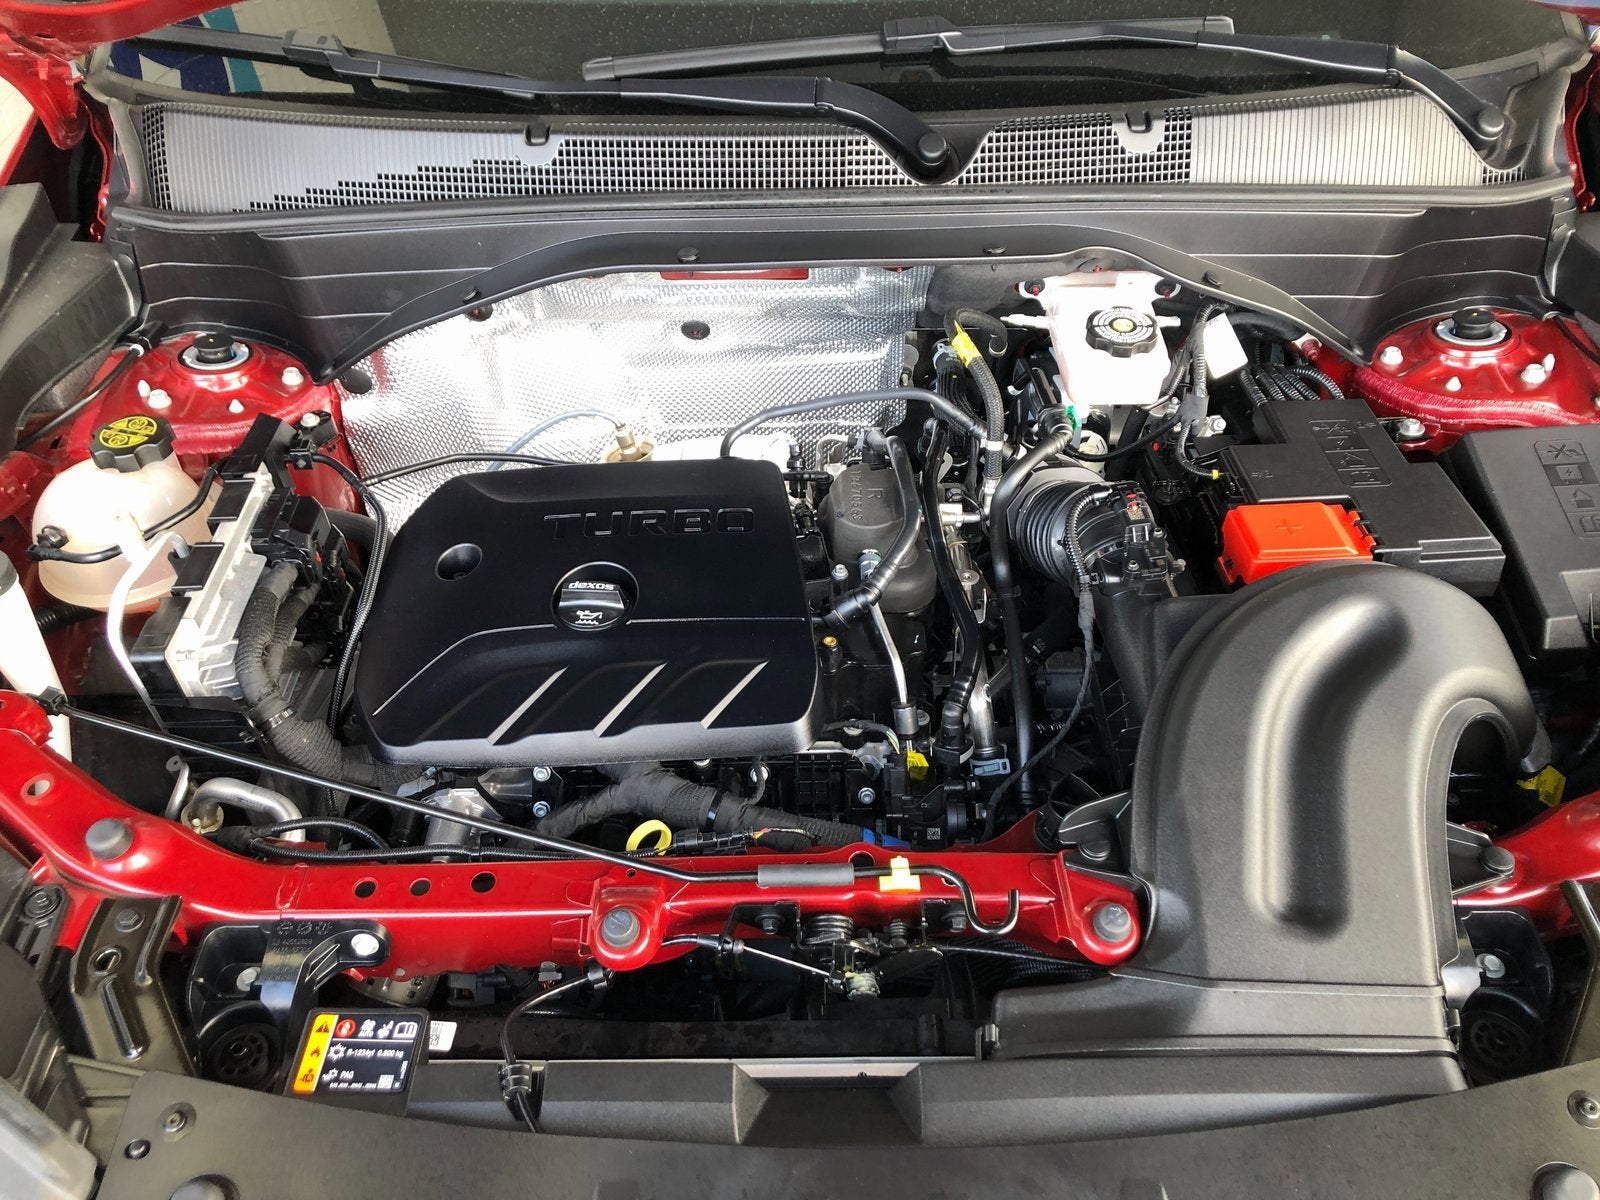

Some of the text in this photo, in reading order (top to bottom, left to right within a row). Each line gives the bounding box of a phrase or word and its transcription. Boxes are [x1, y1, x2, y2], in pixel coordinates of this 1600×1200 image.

[867, 488, 884, 499] R
[544, 508, 755, 540] TURBO
[568, 581, 616, 590] dexos
[395, 1049, 404, 1059] kg
